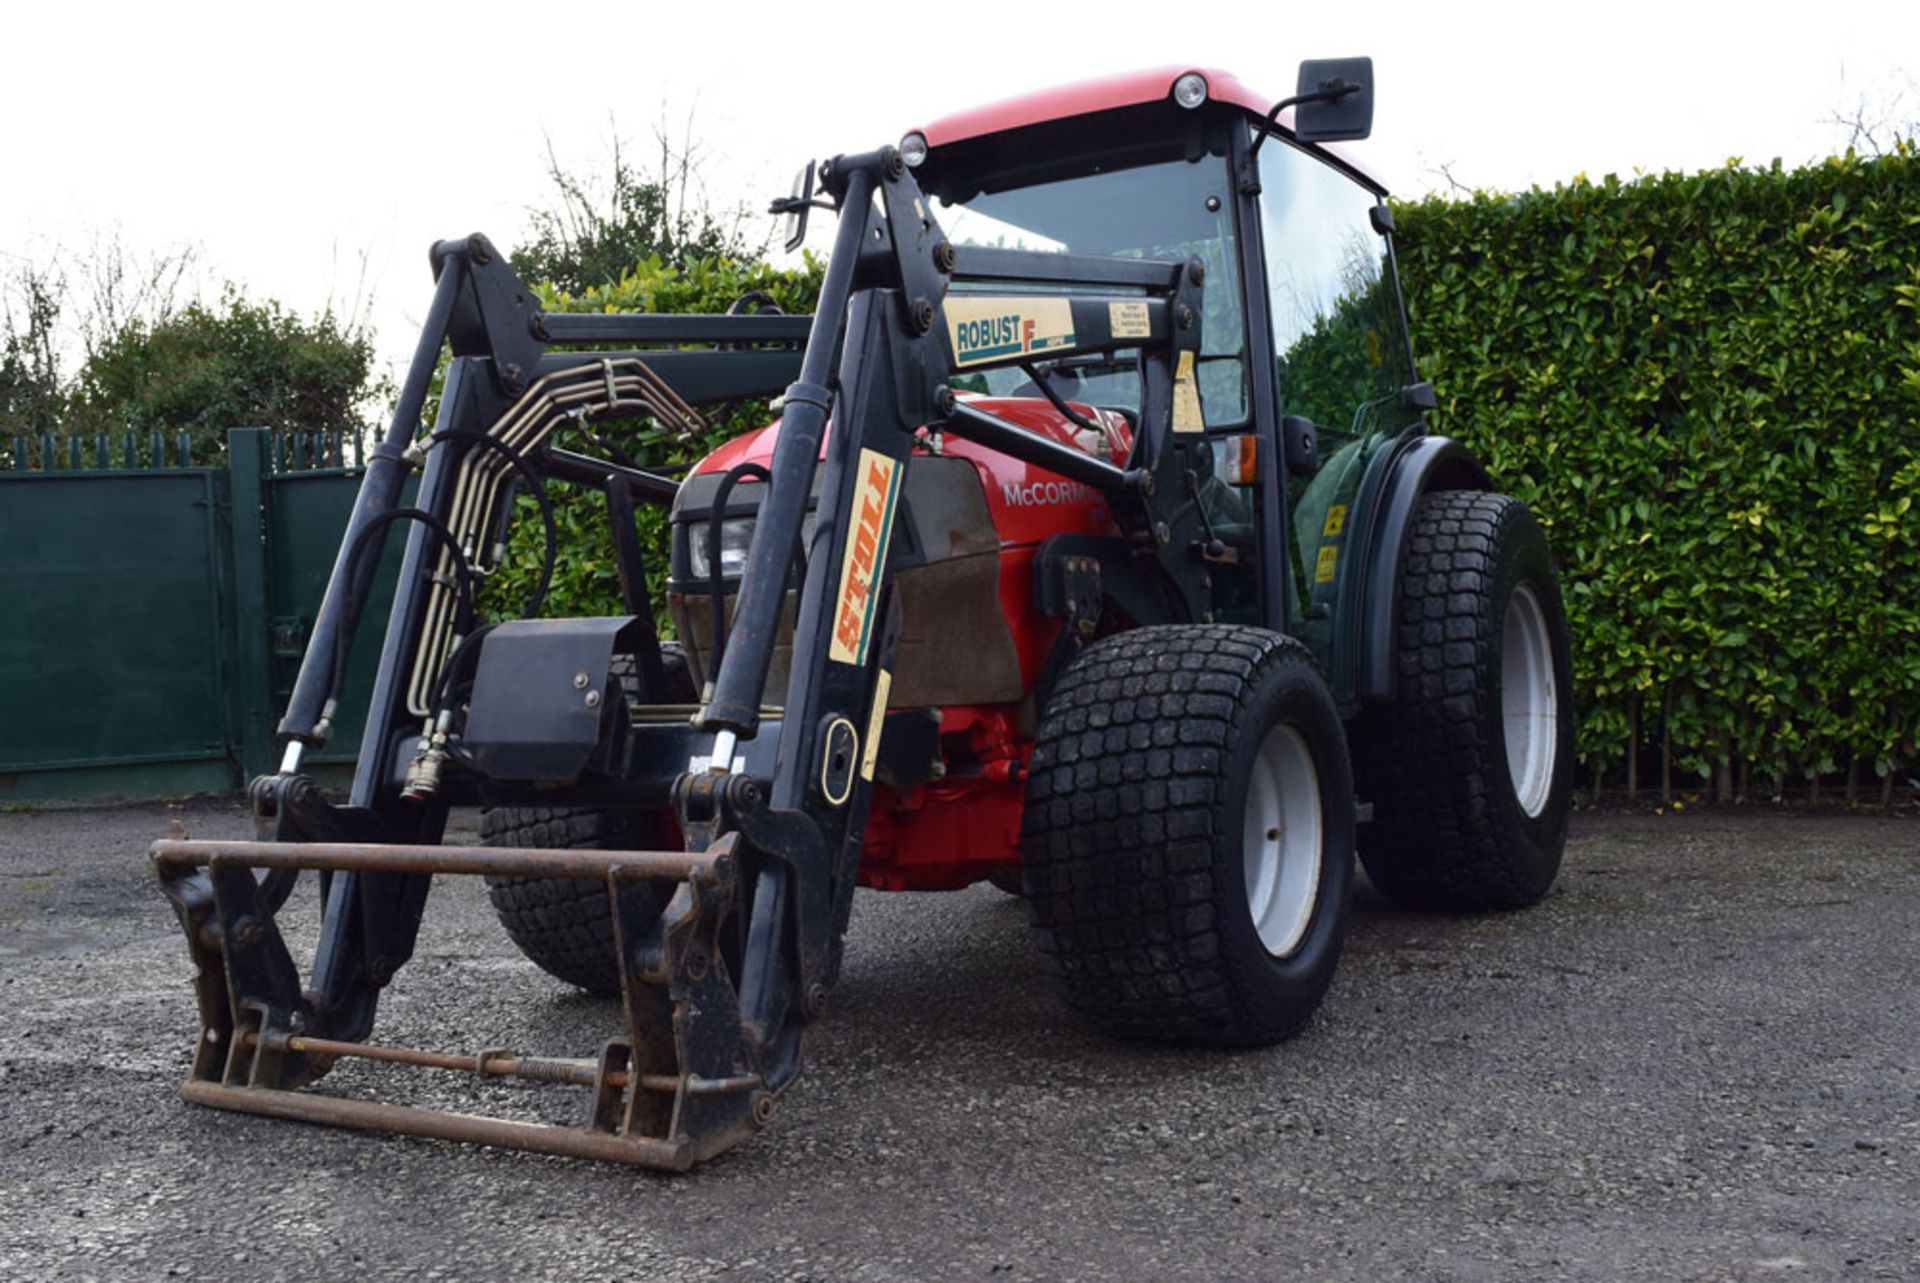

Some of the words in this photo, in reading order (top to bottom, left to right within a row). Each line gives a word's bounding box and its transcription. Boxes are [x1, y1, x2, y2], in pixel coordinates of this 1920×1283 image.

[957, 315, 1021, 351] ROBUST
[1023, 319, 1035, 353] F
[1003, 481, 1095, 507] McCORM
[836, 459, 892, 656] STOLL
